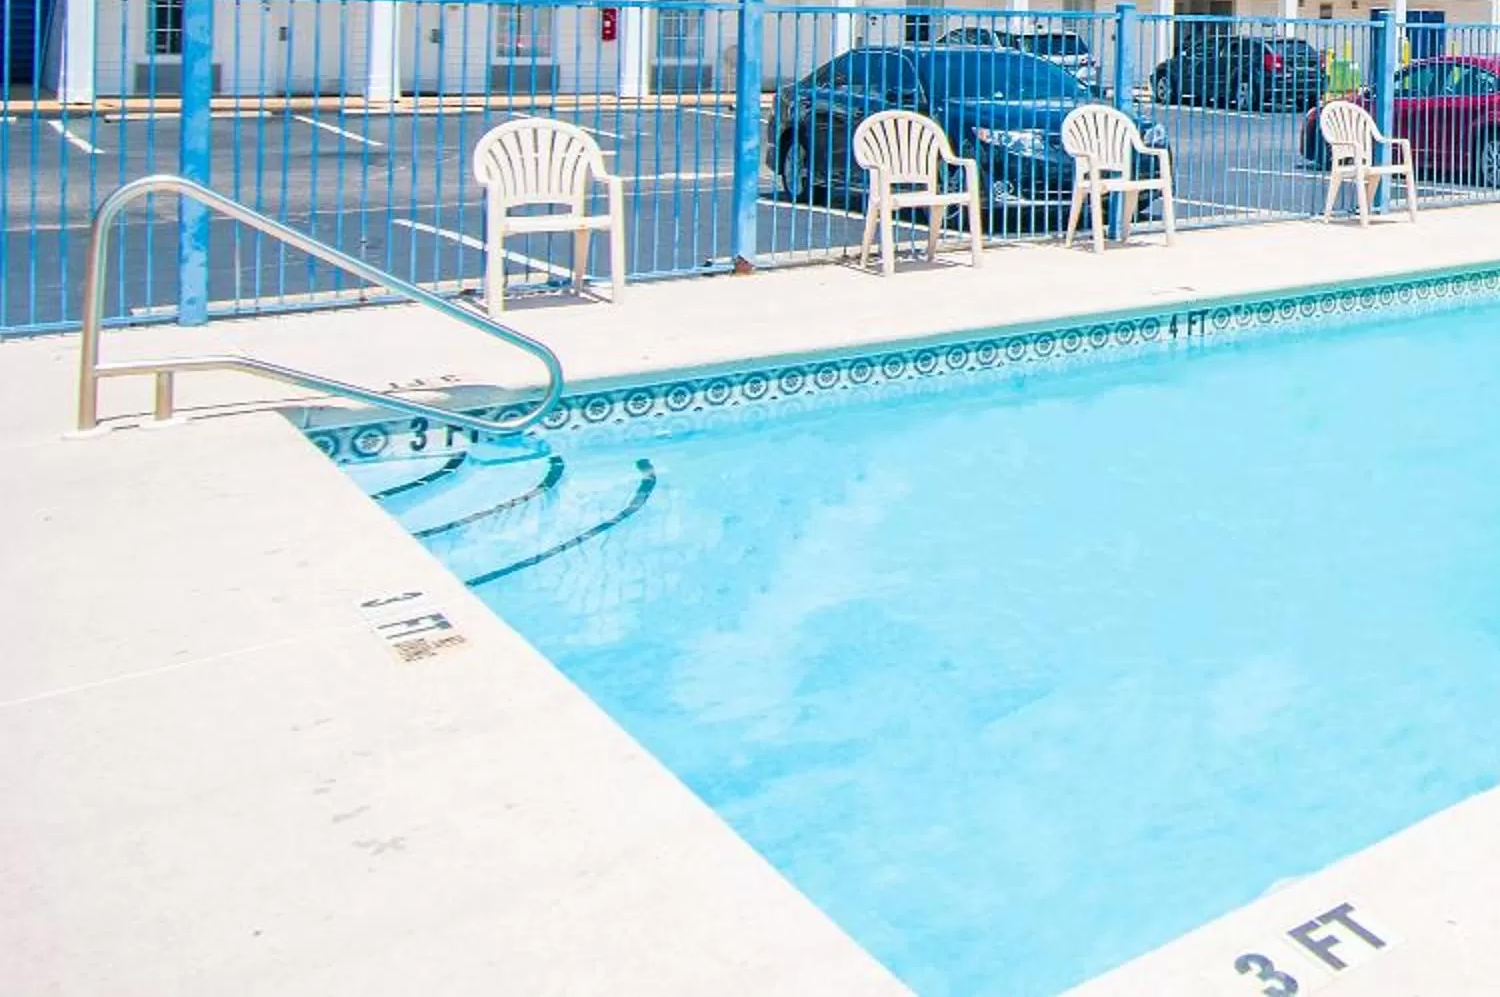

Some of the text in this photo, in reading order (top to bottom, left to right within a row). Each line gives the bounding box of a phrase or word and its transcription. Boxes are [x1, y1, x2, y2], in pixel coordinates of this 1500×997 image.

[1169, 309, 1210, 338] 4 FT
[409, 416, 429, 451] 3
[377, 612, 453, 640] FT
[1234, 902, 1387, 997] 3 FT
